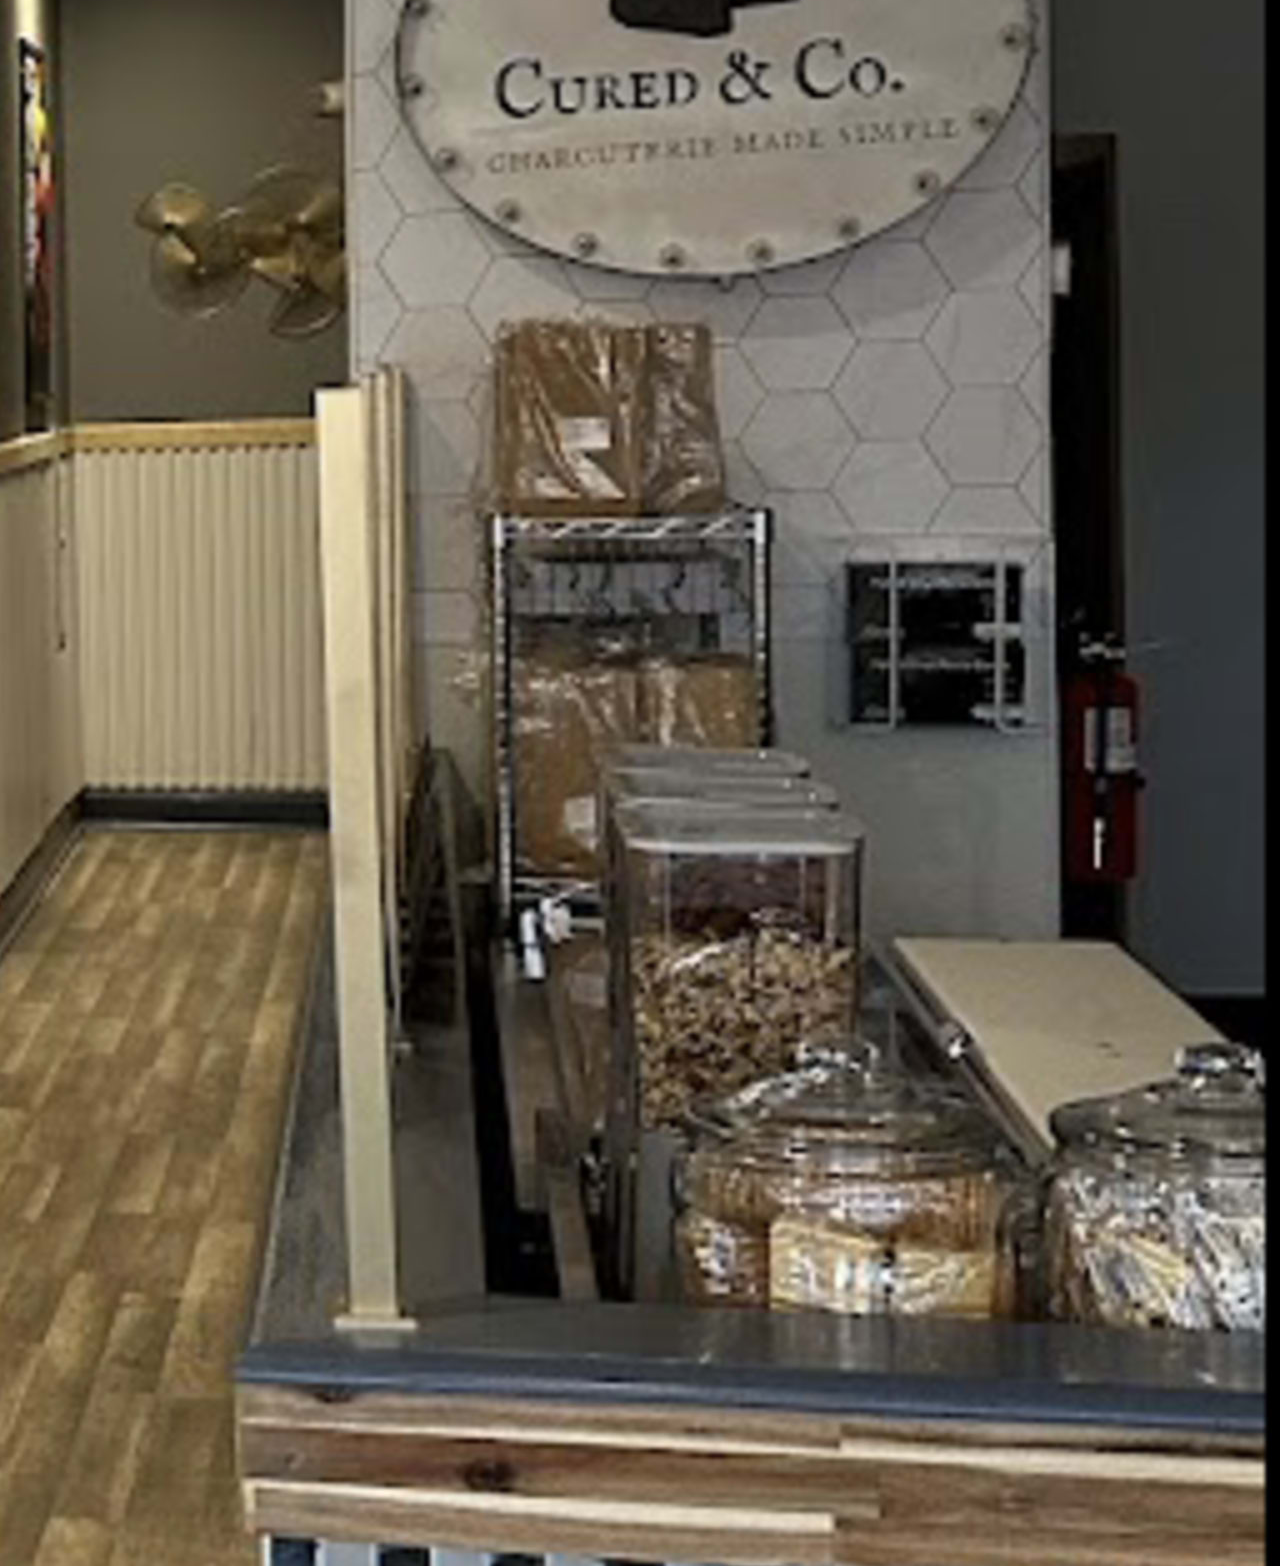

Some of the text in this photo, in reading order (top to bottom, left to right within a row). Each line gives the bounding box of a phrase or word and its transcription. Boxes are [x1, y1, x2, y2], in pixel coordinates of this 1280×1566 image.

[495, 57, 700, 119] CURED
[718, 49, 772, 105] &
[487, 116, 960, 174] CHARCUTERIE MADE SIMPLE
